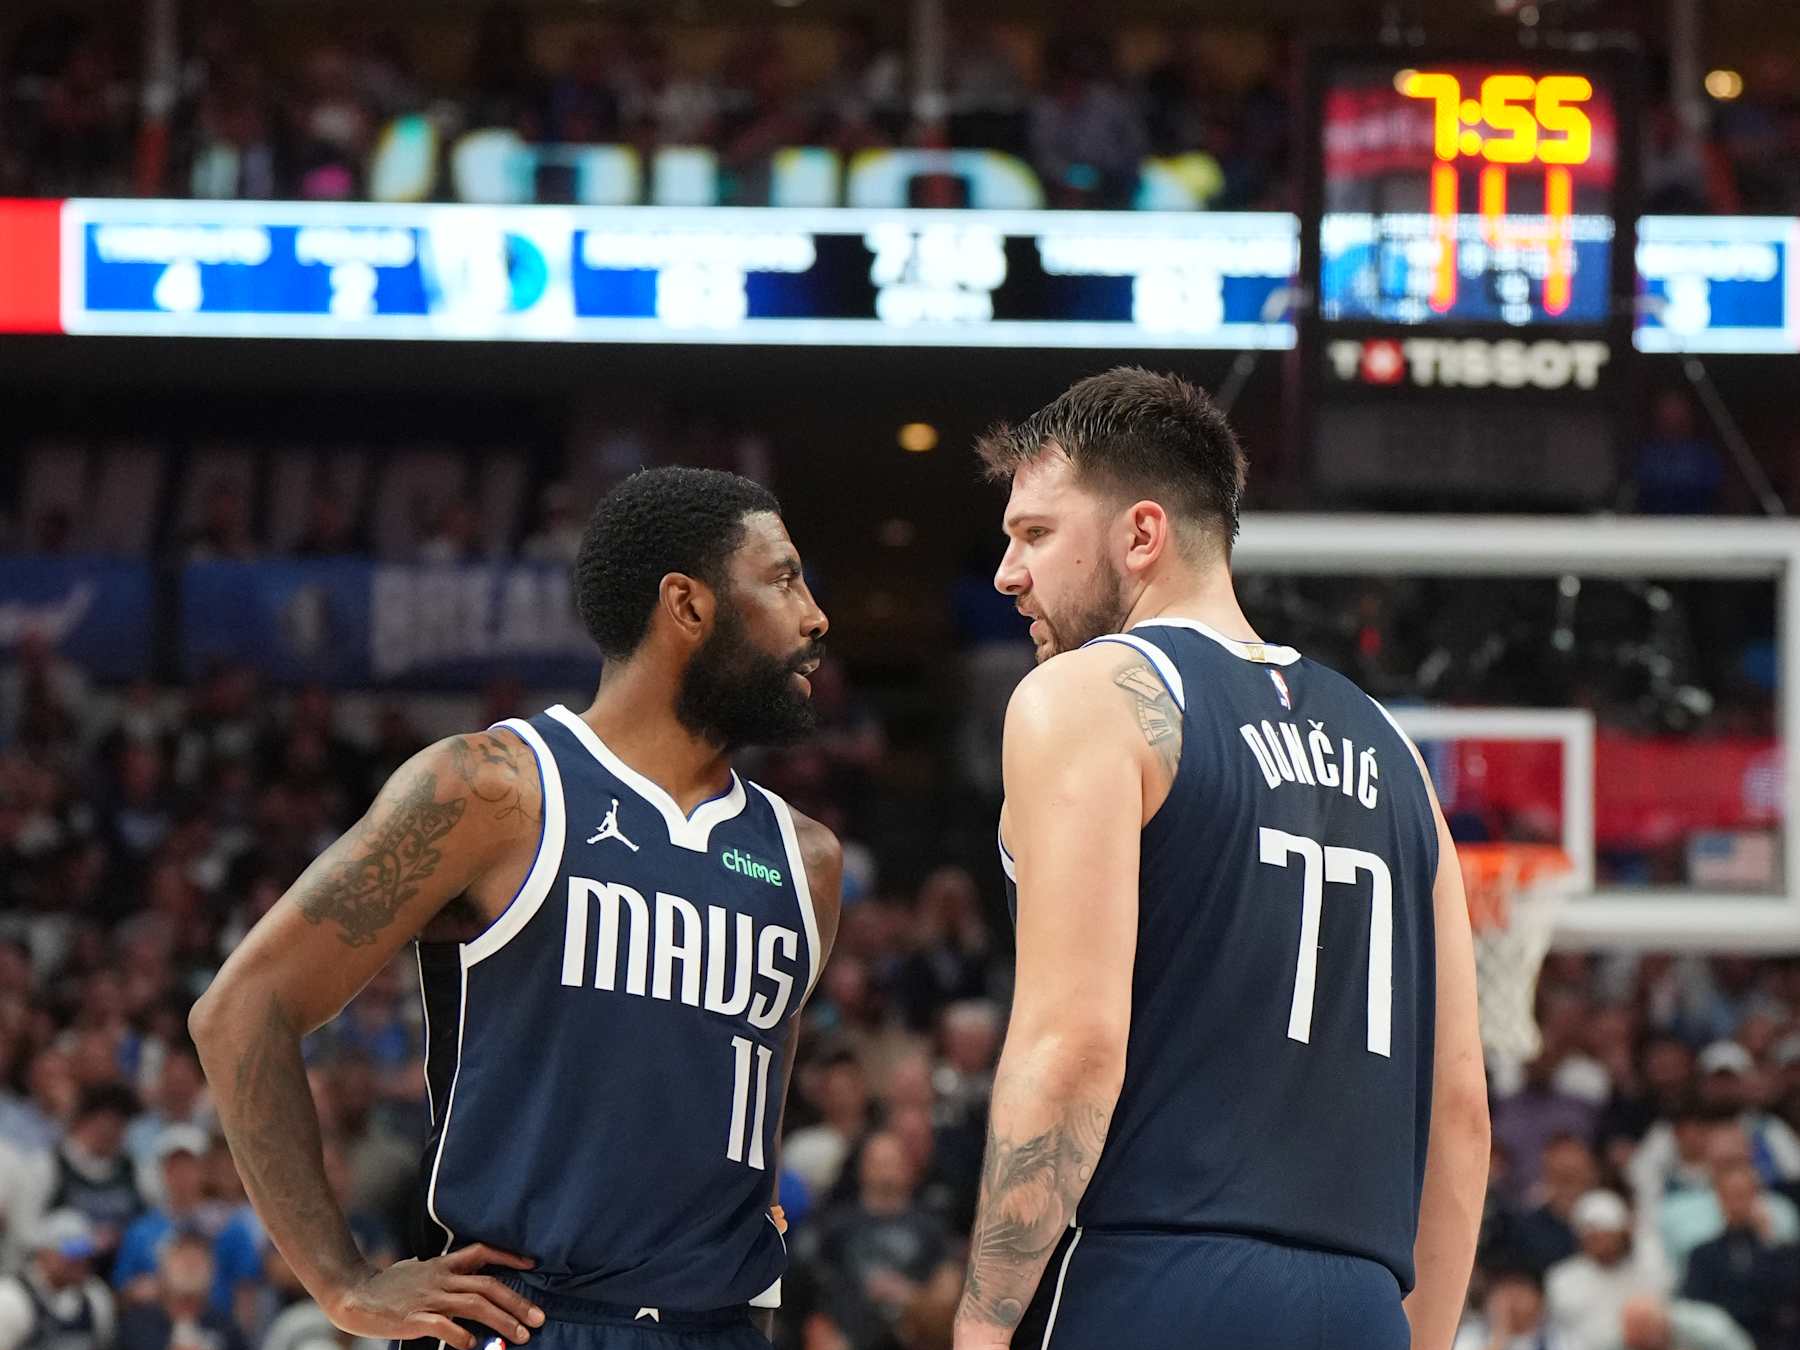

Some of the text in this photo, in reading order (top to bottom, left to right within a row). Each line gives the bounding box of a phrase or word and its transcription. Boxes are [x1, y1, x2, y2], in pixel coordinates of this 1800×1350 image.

[1405, 73, 1592, 164] 7:55
[1404, 336, 1610, 390] TISSOT
[1239, 719, 1379, 809] DONČIĆ
[722, 848, 782, 887] chime
[561, 875, 799, 1030] MAVS
[1258, 826, 1393, 1058] 77
[726, 1034, 773, 1170] 11
